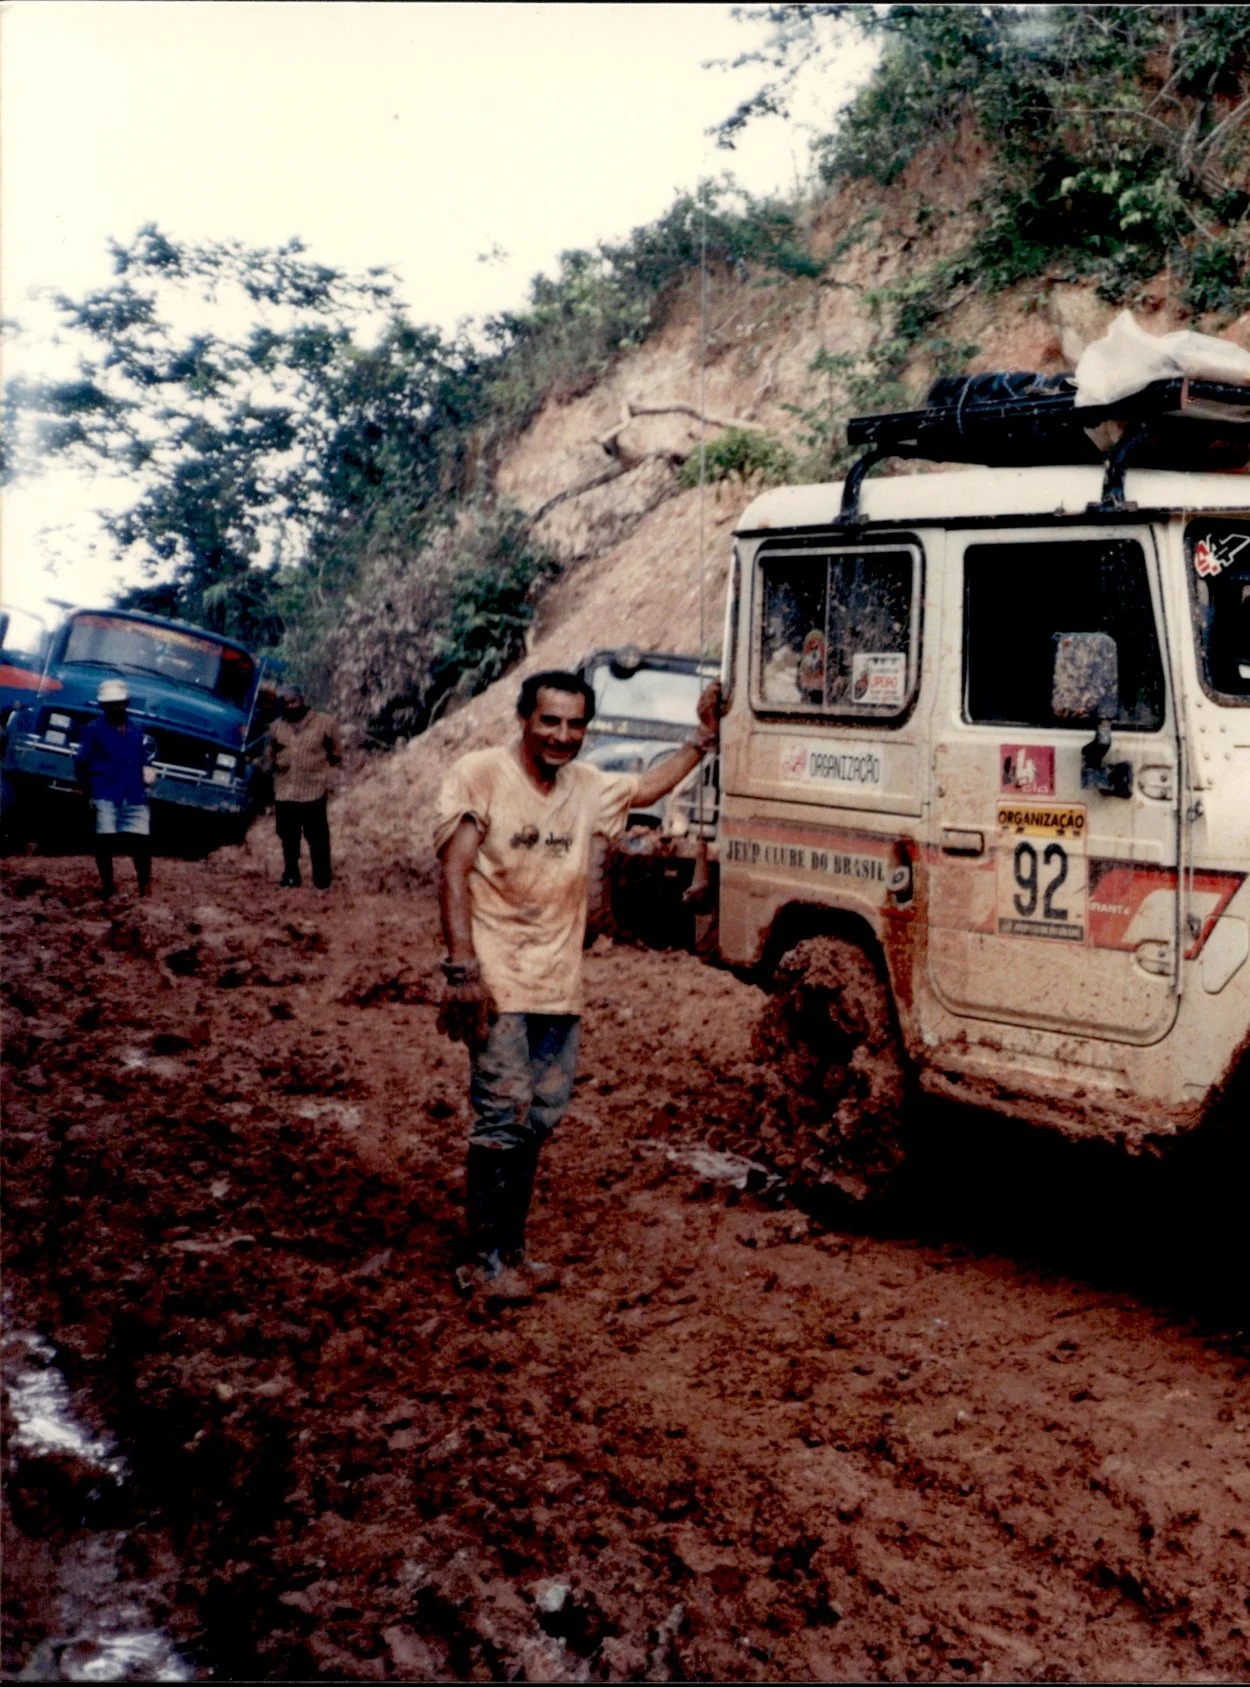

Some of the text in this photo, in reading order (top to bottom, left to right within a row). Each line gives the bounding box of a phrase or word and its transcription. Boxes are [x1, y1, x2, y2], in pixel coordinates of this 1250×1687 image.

[810, 752, 880, 784] ORGANIZAÇÃO
[998, 810, 1085, 830] ORGANIZAÇÃO
[726, 840, 885, 882] JEEP CLUBE DO BRASIL
[1013, 841, 1069, 920] 92
